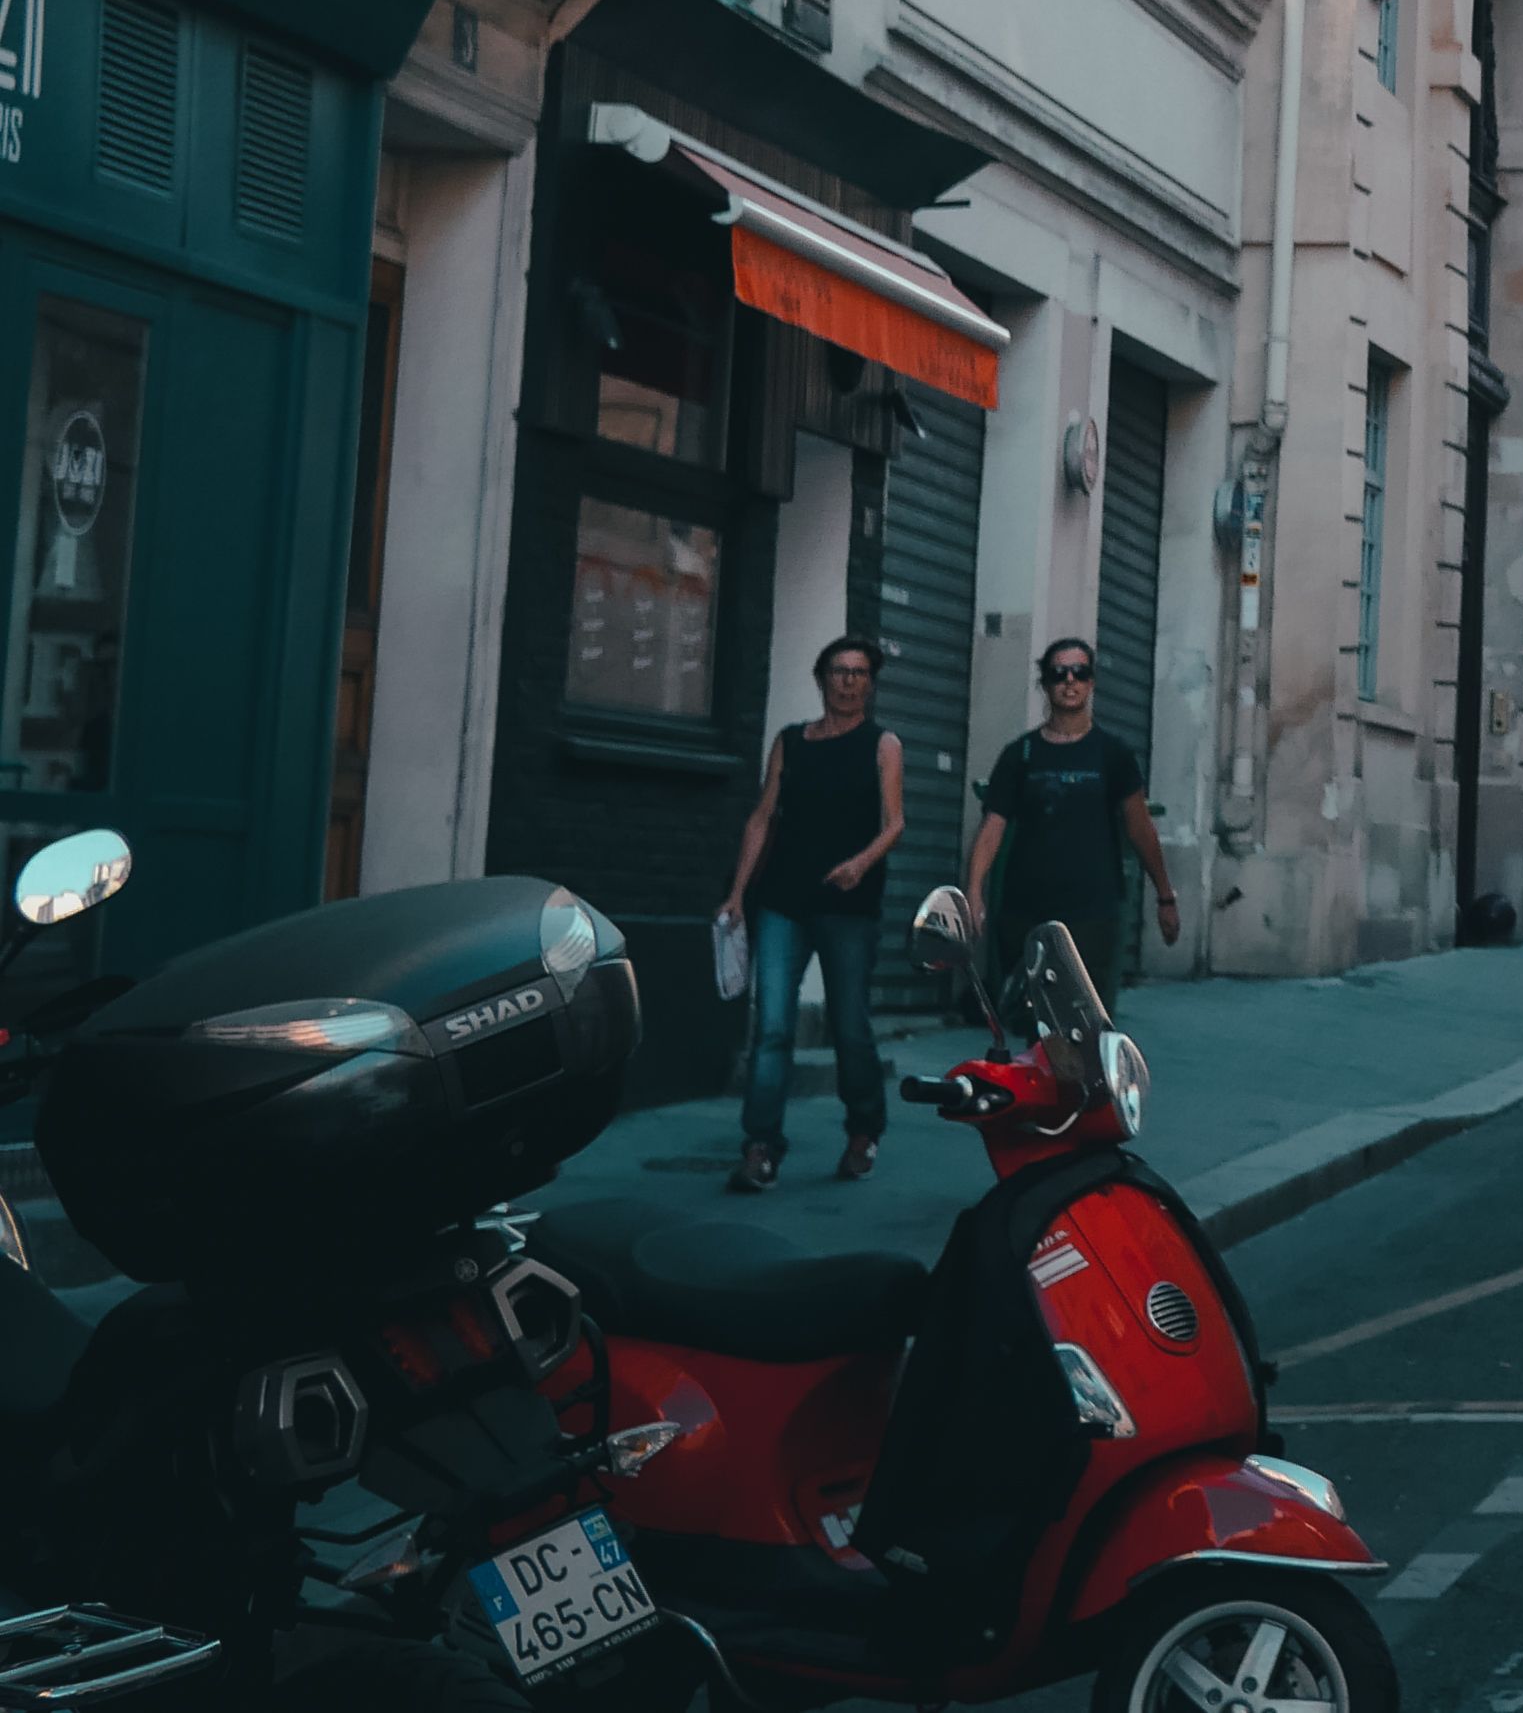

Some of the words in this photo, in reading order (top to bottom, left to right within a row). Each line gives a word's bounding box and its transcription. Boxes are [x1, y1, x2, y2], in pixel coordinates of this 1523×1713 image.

[445, 989, 544, 1040] SHAD
[600, 1540, 621, 1566] 47
[493, 1596, 503, 1612] F
[514, 1569, 650, 1661] 465-CN
